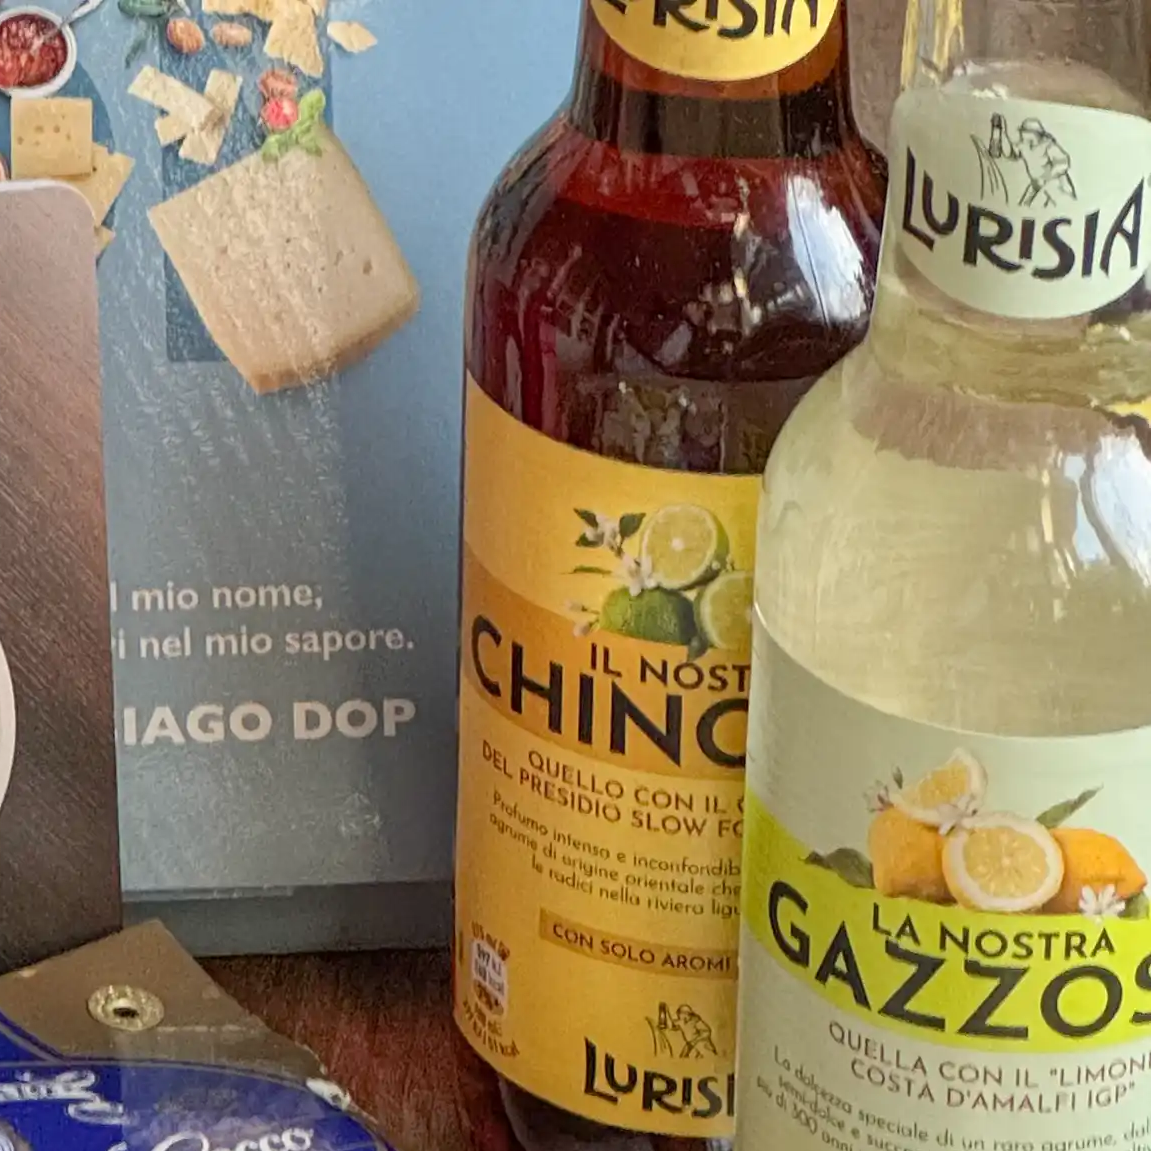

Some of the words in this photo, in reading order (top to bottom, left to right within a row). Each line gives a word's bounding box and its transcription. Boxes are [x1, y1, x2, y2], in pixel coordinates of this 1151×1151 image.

[901, 145, 1147, 280] LURISIA
[131, 581, 199, 611] mio
[139, 627, 192, 660] nel
[205, 624, 273, 657] mio
[285, 626, 414, 661] sapore.
[590, 642, 622, 680] IL
[641, 654, 750, 693] NOST
[293, 697, 417, 740] DOP
[482, 740, 513, 779] DEL
[519, 767, 621, 823] PRESIDIO
[631, 810, 708, 838] SLOW
[528, 749, 624, 800] QUELLO
[634, 786, 694, 812] CON
[705, 796, 726, 814] IL
[489, 812, 538, 851] agrume
[542, 843, 557, 860] di
[562, 853, 619, 882] origine
[625, 872, 705, 896] orientale
[493, 790, 548, 836] Profumo
[553, 828, 611, 860] intenso
[616, 850, 627, 863] e
[531, 855, 544, 874] le
[549, 869, 594, 894] radici
[599, 883, 641, 906] nella
[647, 895, 705, 915] riviera
[552, 922, 595, 957] CON
[600, 940, 656, 969] SOLO
[660, 952, 732, 974] AROMI
[873, 902, 920, 947] LA
[939, 920, 1115, 961] NOSTRA
[829, 1020, 928, 1077] QUELLA
[939, 1060, 1003, 1087] CON
[1015, 1067, 1039, 1088] IL
[850, 1057, 935, 1103] COSTA
[946, 1087, 1077, 1114] D'AMALFI
[1088, 1081, 1136, 1110] IGP"
[850, 1126, 861, 1139] e
[858, 1109, 929, 1142] speciale
[935, 1127, 954, 1147] di
[961, 1136, 985, 1151] un
